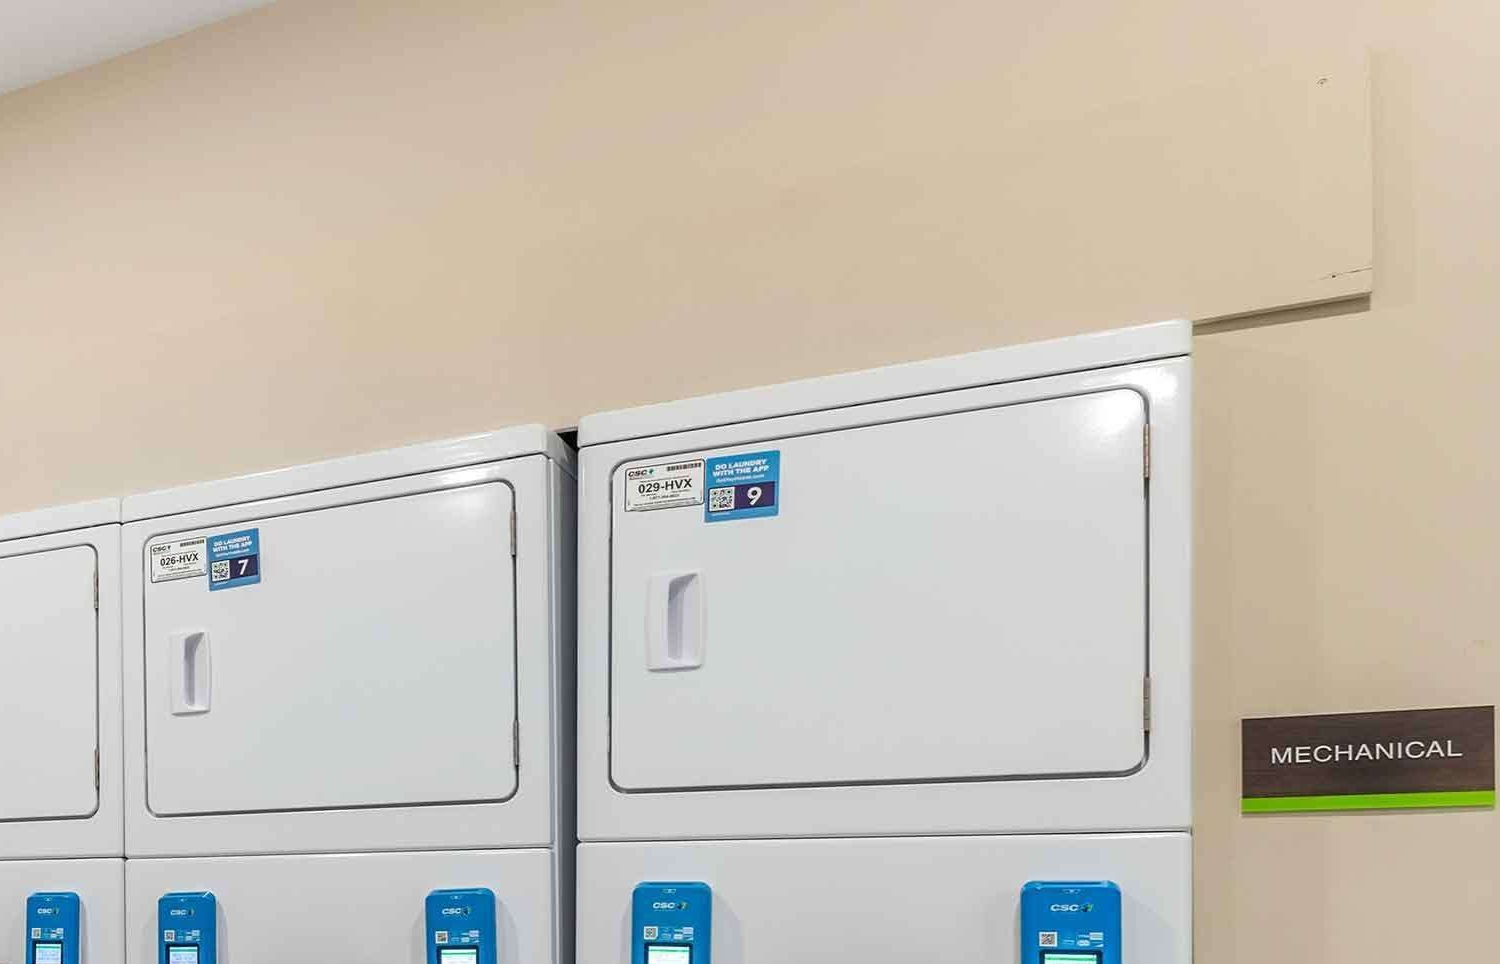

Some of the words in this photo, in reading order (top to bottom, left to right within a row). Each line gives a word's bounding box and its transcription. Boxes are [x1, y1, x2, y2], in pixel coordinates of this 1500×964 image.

[728, 459, 767, 469] LAUNDRY
[638, 478, 692, 494] 029-HVX
[747, 486, 763, 506] 9
[160, 552, 199, 566] 026-HVX
[238, 559, 249, 575] 7
[1271, 740, 1463, 764] MECHANICAL
[1050, 904, 1080, 912] CSC
